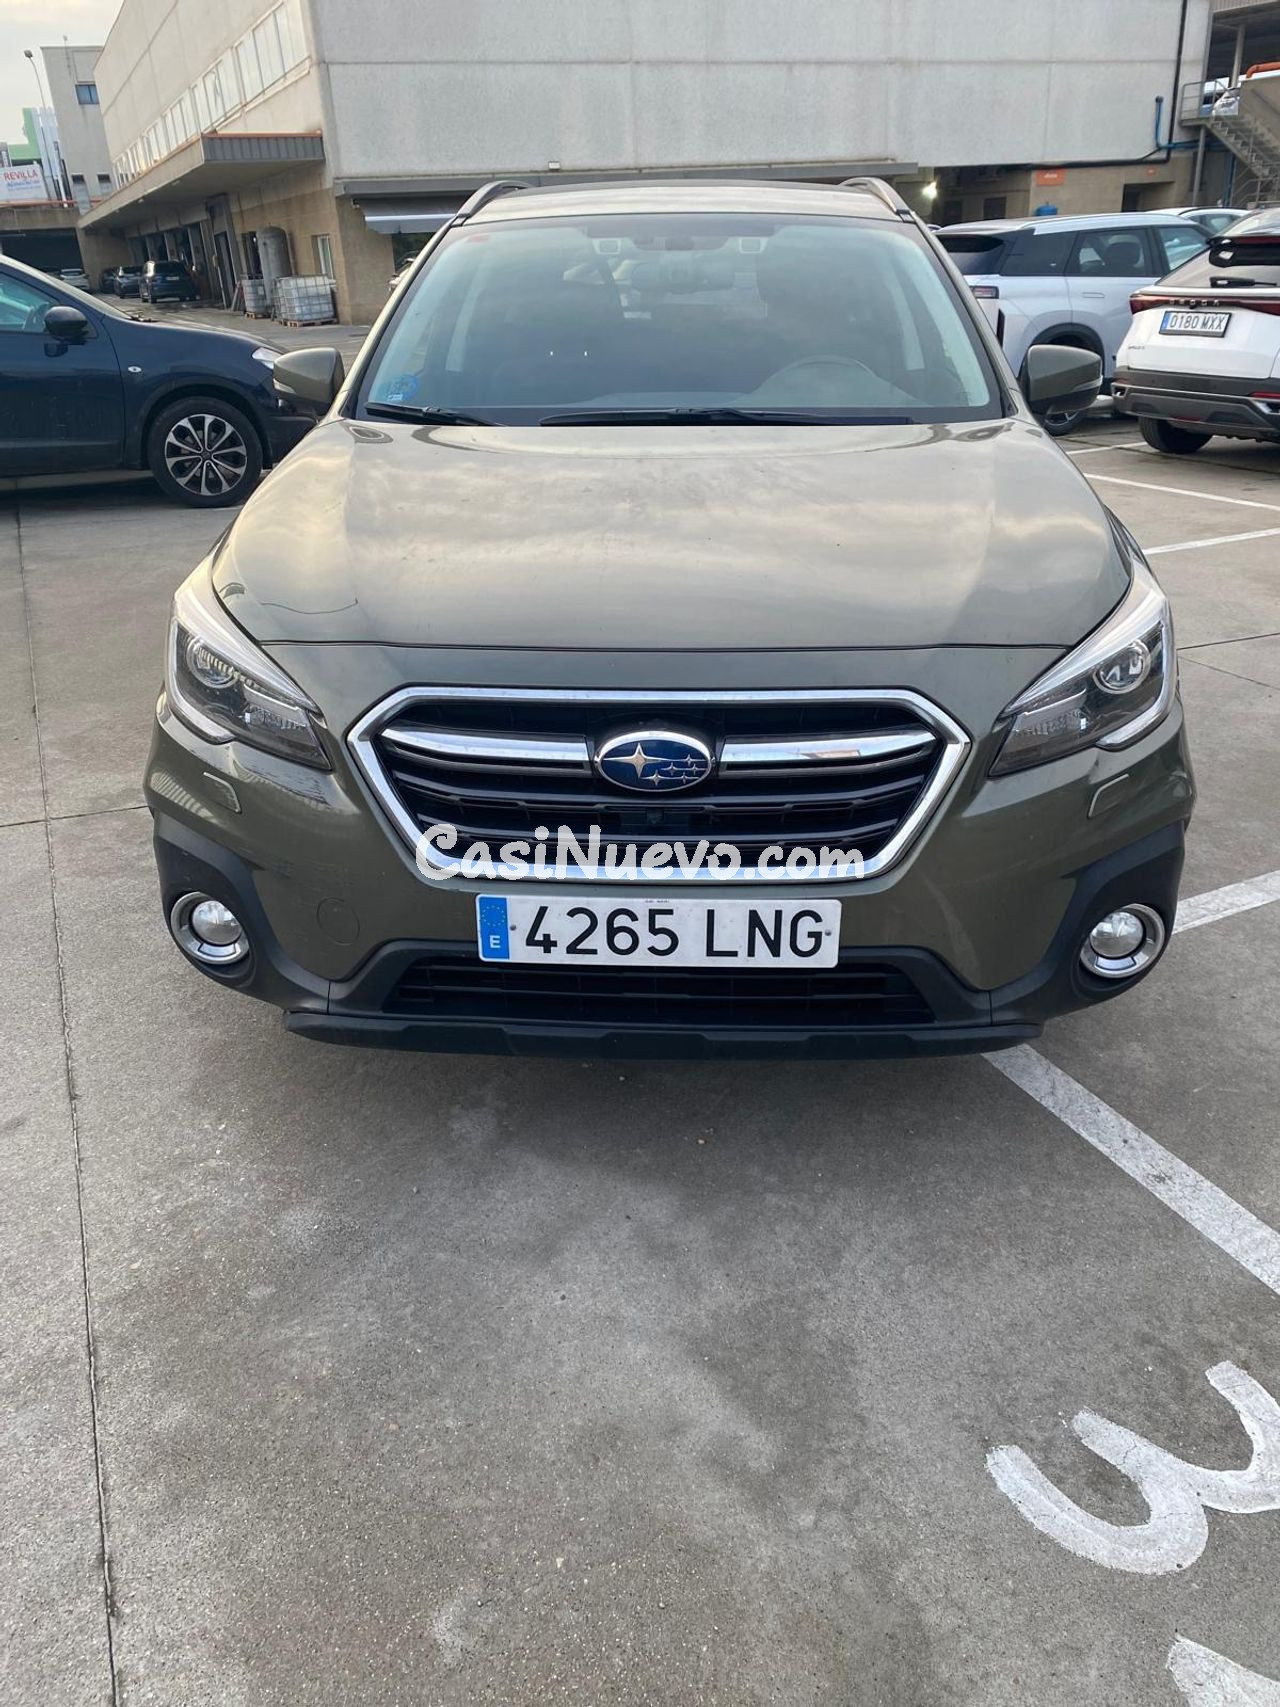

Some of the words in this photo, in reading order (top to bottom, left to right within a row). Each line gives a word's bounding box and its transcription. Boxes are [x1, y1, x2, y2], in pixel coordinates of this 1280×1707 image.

[4, 169, 38, 180] REVILLA
[1170, 314, 1199, 329] 0180
[1201, 316, 1225, 330] MXX
[525, 905, 679, 957] 4265
[705, 908, 824, 958] LNG
[489, 934, 501, 949] E
